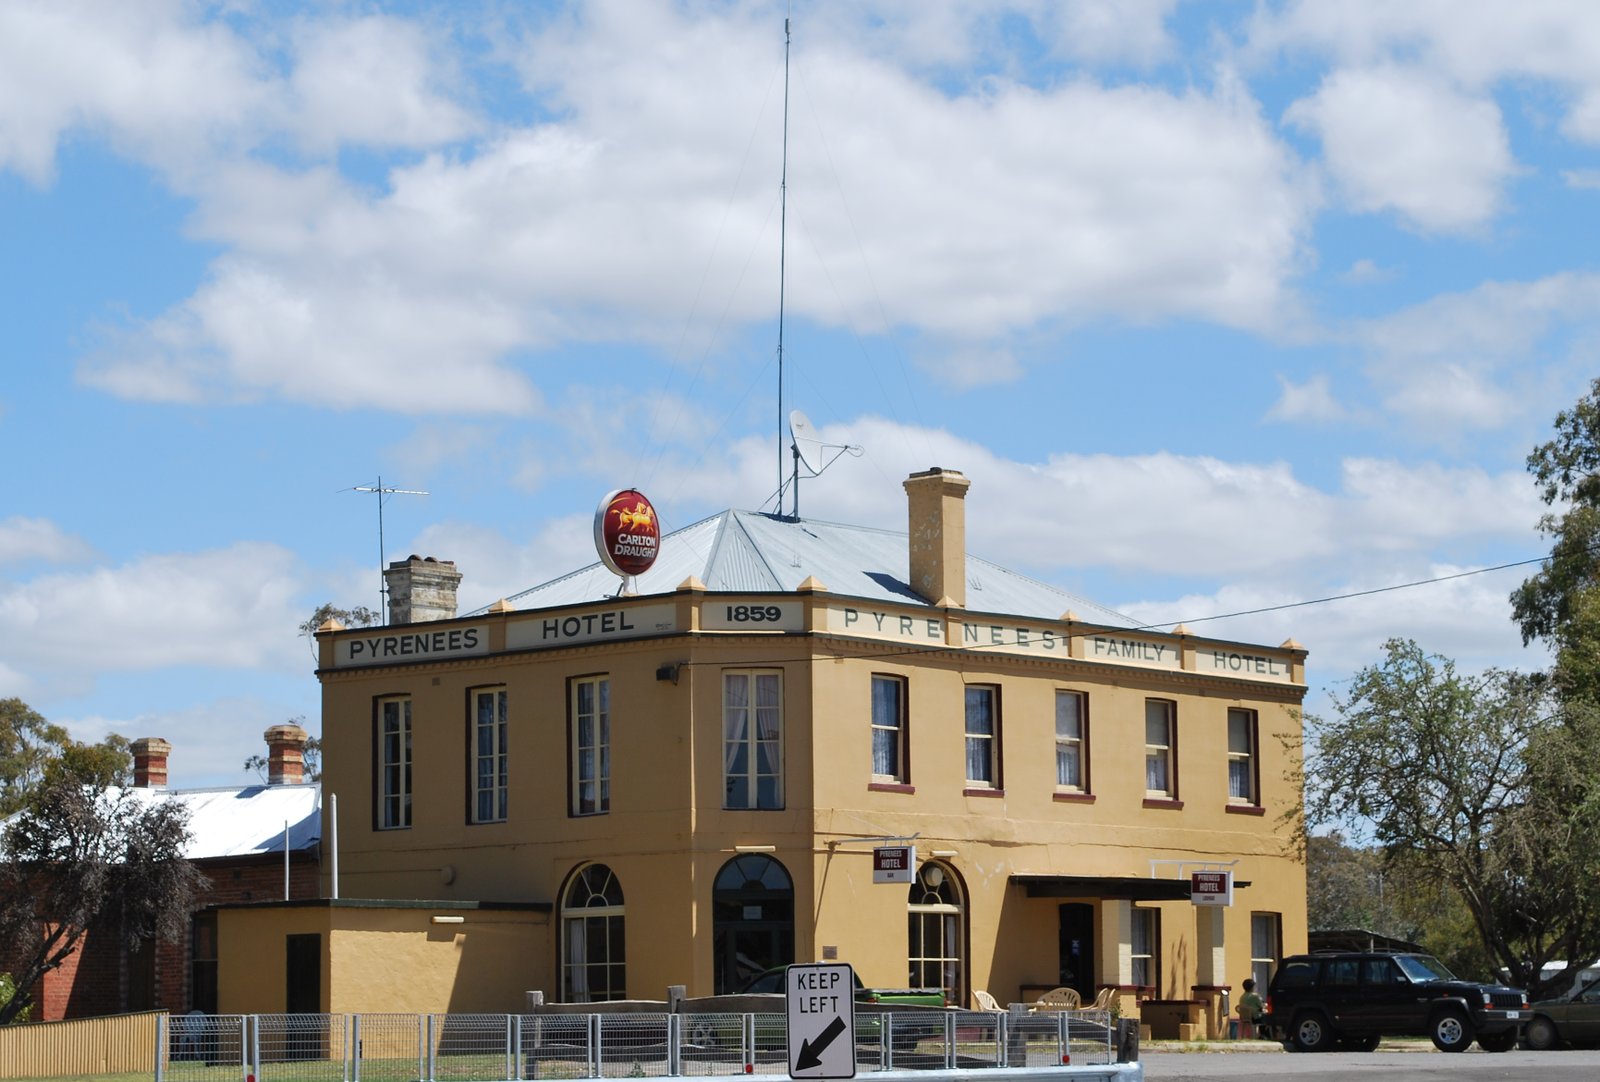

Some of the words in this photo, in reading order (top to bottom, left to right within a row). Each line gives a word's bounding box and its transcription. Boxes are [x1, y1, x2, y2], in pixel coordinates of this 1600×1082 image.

[618, 533, 655, 546] CARLTON
[614, 544, 655, 557] DRAUGHT
[726, 605, 782, 622] 1859
[349, 628, 479, 659] PYRENEES
[542, 611, 634, 639] HOTEL
[1094, 637, 1166, 662] FAMILY
[1213, 651, 1281, 676] HOTEL
[881, 859, 901, 868] HOTEL
[798, 972, 840, 990] KEEP
[800, 996, 839, 1013] LEFT
